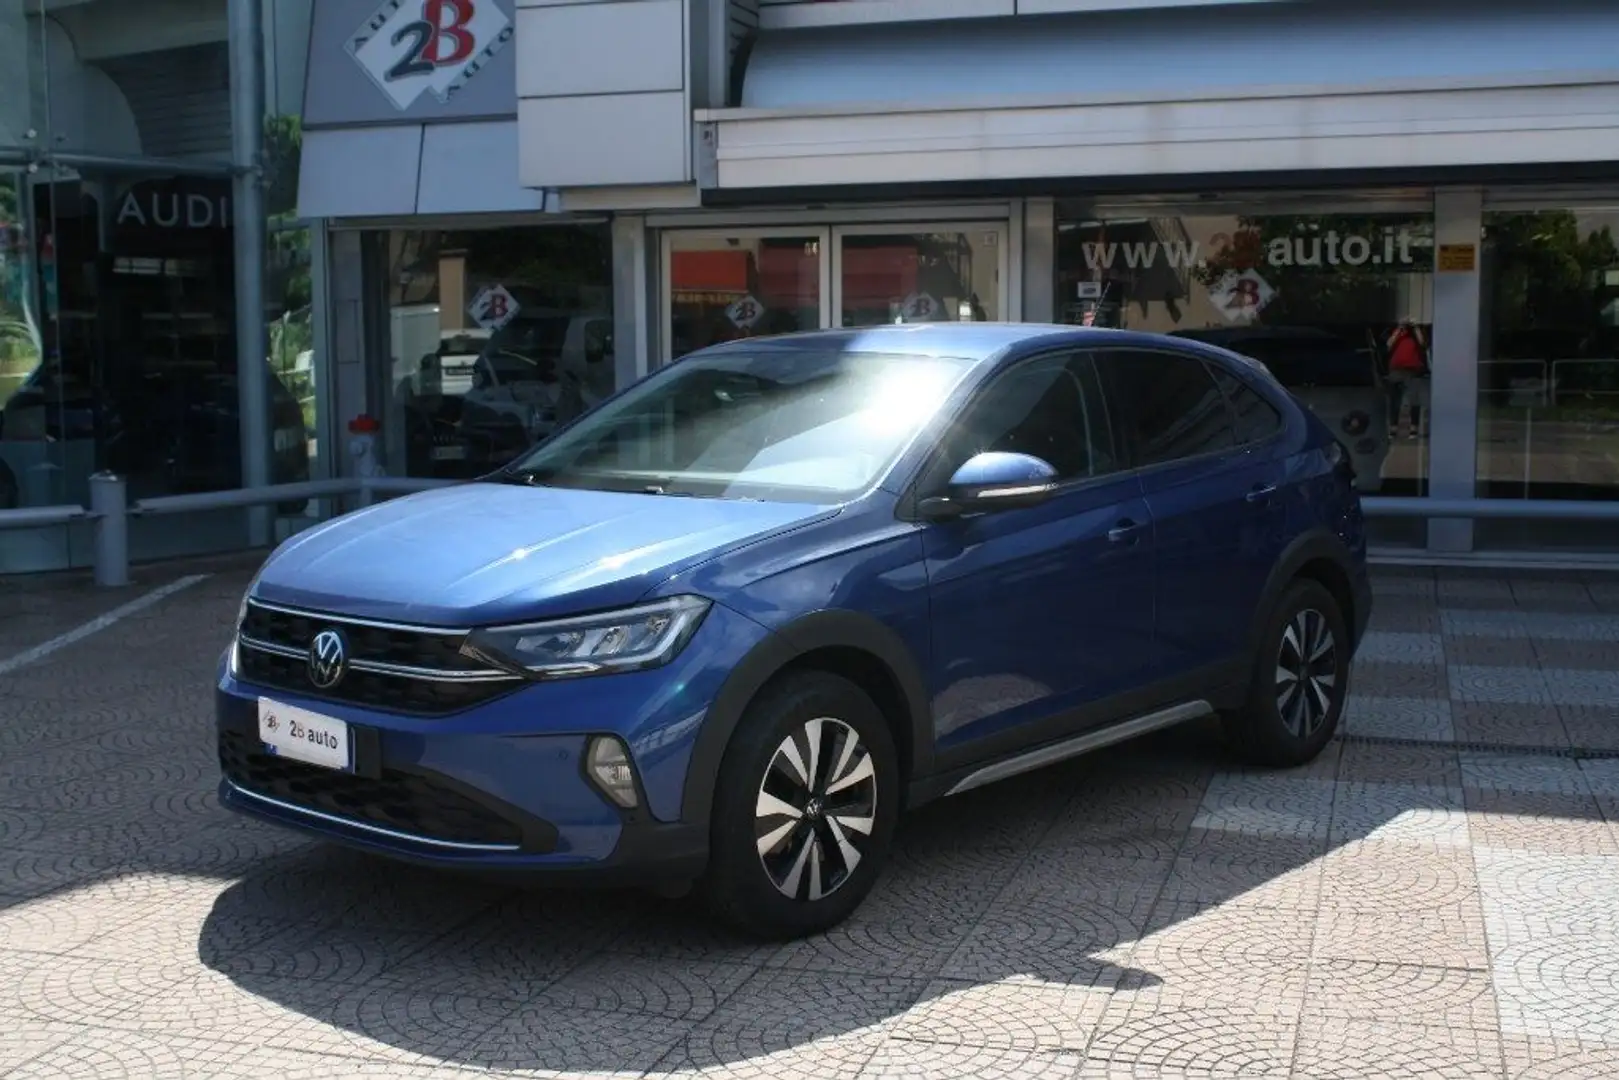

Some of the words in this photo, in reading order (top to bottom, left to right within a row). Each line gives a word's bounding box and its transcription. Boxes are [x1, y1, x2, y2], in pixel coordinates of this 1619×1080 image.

[384, 0, 476, 82] 2B
[446, 26, 515, 101] AUTO
[116, 191, 228, 229] AUDI
[479, 293, 509, 322] 2B
[307, 729, 339, 750] auto
